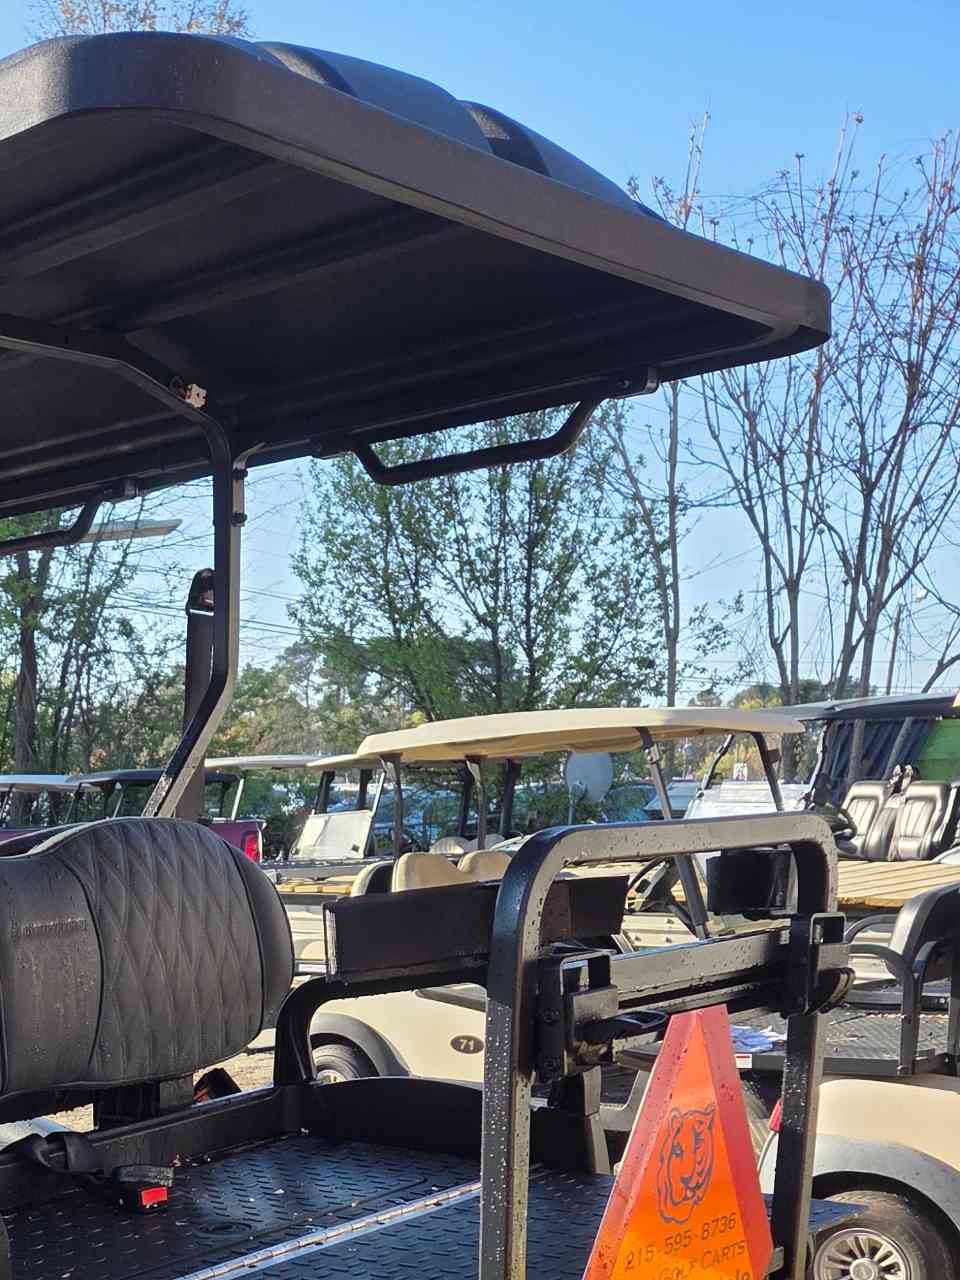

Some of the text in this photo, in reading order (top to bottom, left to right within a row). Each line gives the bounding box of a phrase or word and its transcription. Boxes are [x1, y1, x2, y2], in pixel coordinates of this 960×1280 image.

[460, 1039, 474, 1050] 71
[624, 1212, 737, 1272] 215-595-8736
[700, 1240, 746, 1271] CARTS
